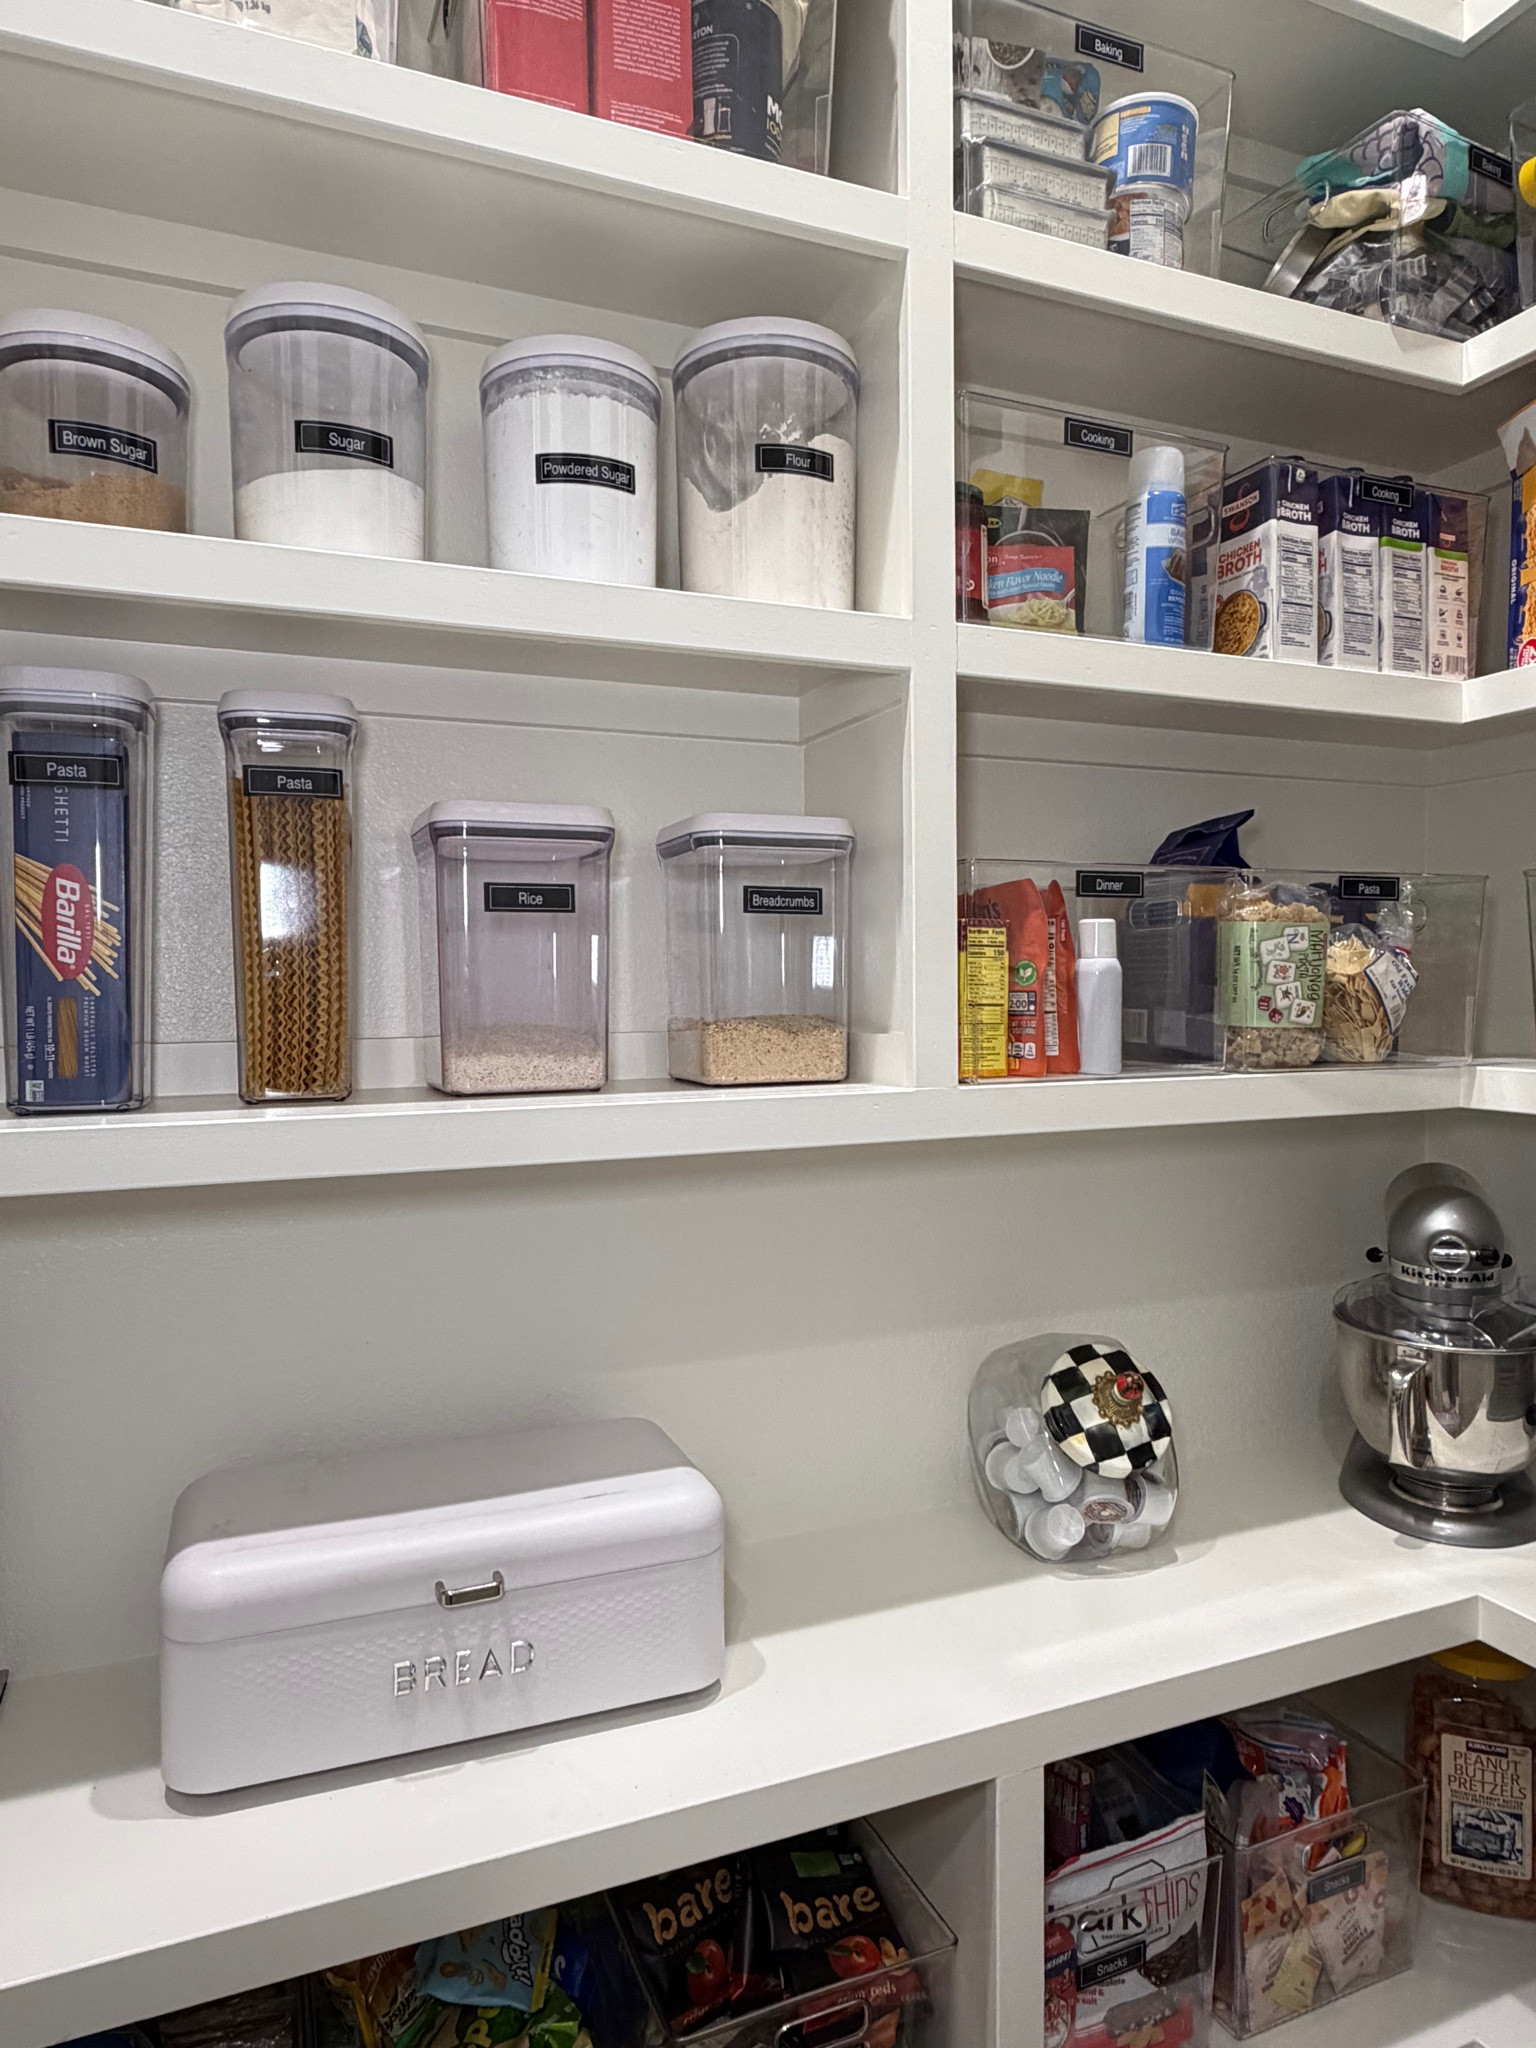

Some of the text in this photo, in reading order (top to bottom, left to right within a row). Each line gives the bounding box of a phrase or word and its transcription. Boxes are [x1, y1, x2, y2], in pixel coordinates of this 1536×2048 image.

[1094, 38, 1123, 61] Baking
[1481, 157, 1502, 176] Baking
[62, 430, 148, 463] Brown Sugar
[328, 431, 366, 453] Sugar
[1080, 428, 1115, 449] Cooking
[785, 452, 811, 469] Flour
[543, 462, 630, 485] Powdered Sugar
[1371, 485, 1400, 503] Cooking
[1223, 493, 1259, 516] SWANSON
[1281, 507, 1312, 521] BROTH
[1282, 500, 1310, 511] CHICKEN
[1341, 520, 1371, 533] BROTH
[1342, 511, 1369, 523] CHICKEN
[1392, 518, 1418, 528] CHICKEN
[1391, 525, 1420, 539] BROTH
[1218, 537, 1261, 564] CHICKEN
[1217, 547, 1262, 580] BROTH
[1033, 570, 1063, 584] Noodle
[46, 762, 87, 778] Pasta
[276, 774, 314, 791] Pasta
[54, 785, 69, 842] GHETTI
[1095, 879, 1123, 892] Dinner
[1358, 883, 1380, 895] Pasta
[518, 891, 543, 906] Rice
[752, 893, 815, 909] Breadcrumbs
[55, 877, 82, 965] Barilla
[1401, 1265, 1494, 1283] KitchenAid
[394, 1640, 535, 1697] BREAD
[1453, 1750, 1521, 1774] PEANUT
[1454, 1762, 1520, 1786] BUTTER
[1448, 1774, 1527, 1800] PRETZELS
[642, 1868, 732, 1945] bare
[779, 1885, 880, 1935] bare
[1096, 1957, 1128, 1977] Snacks
